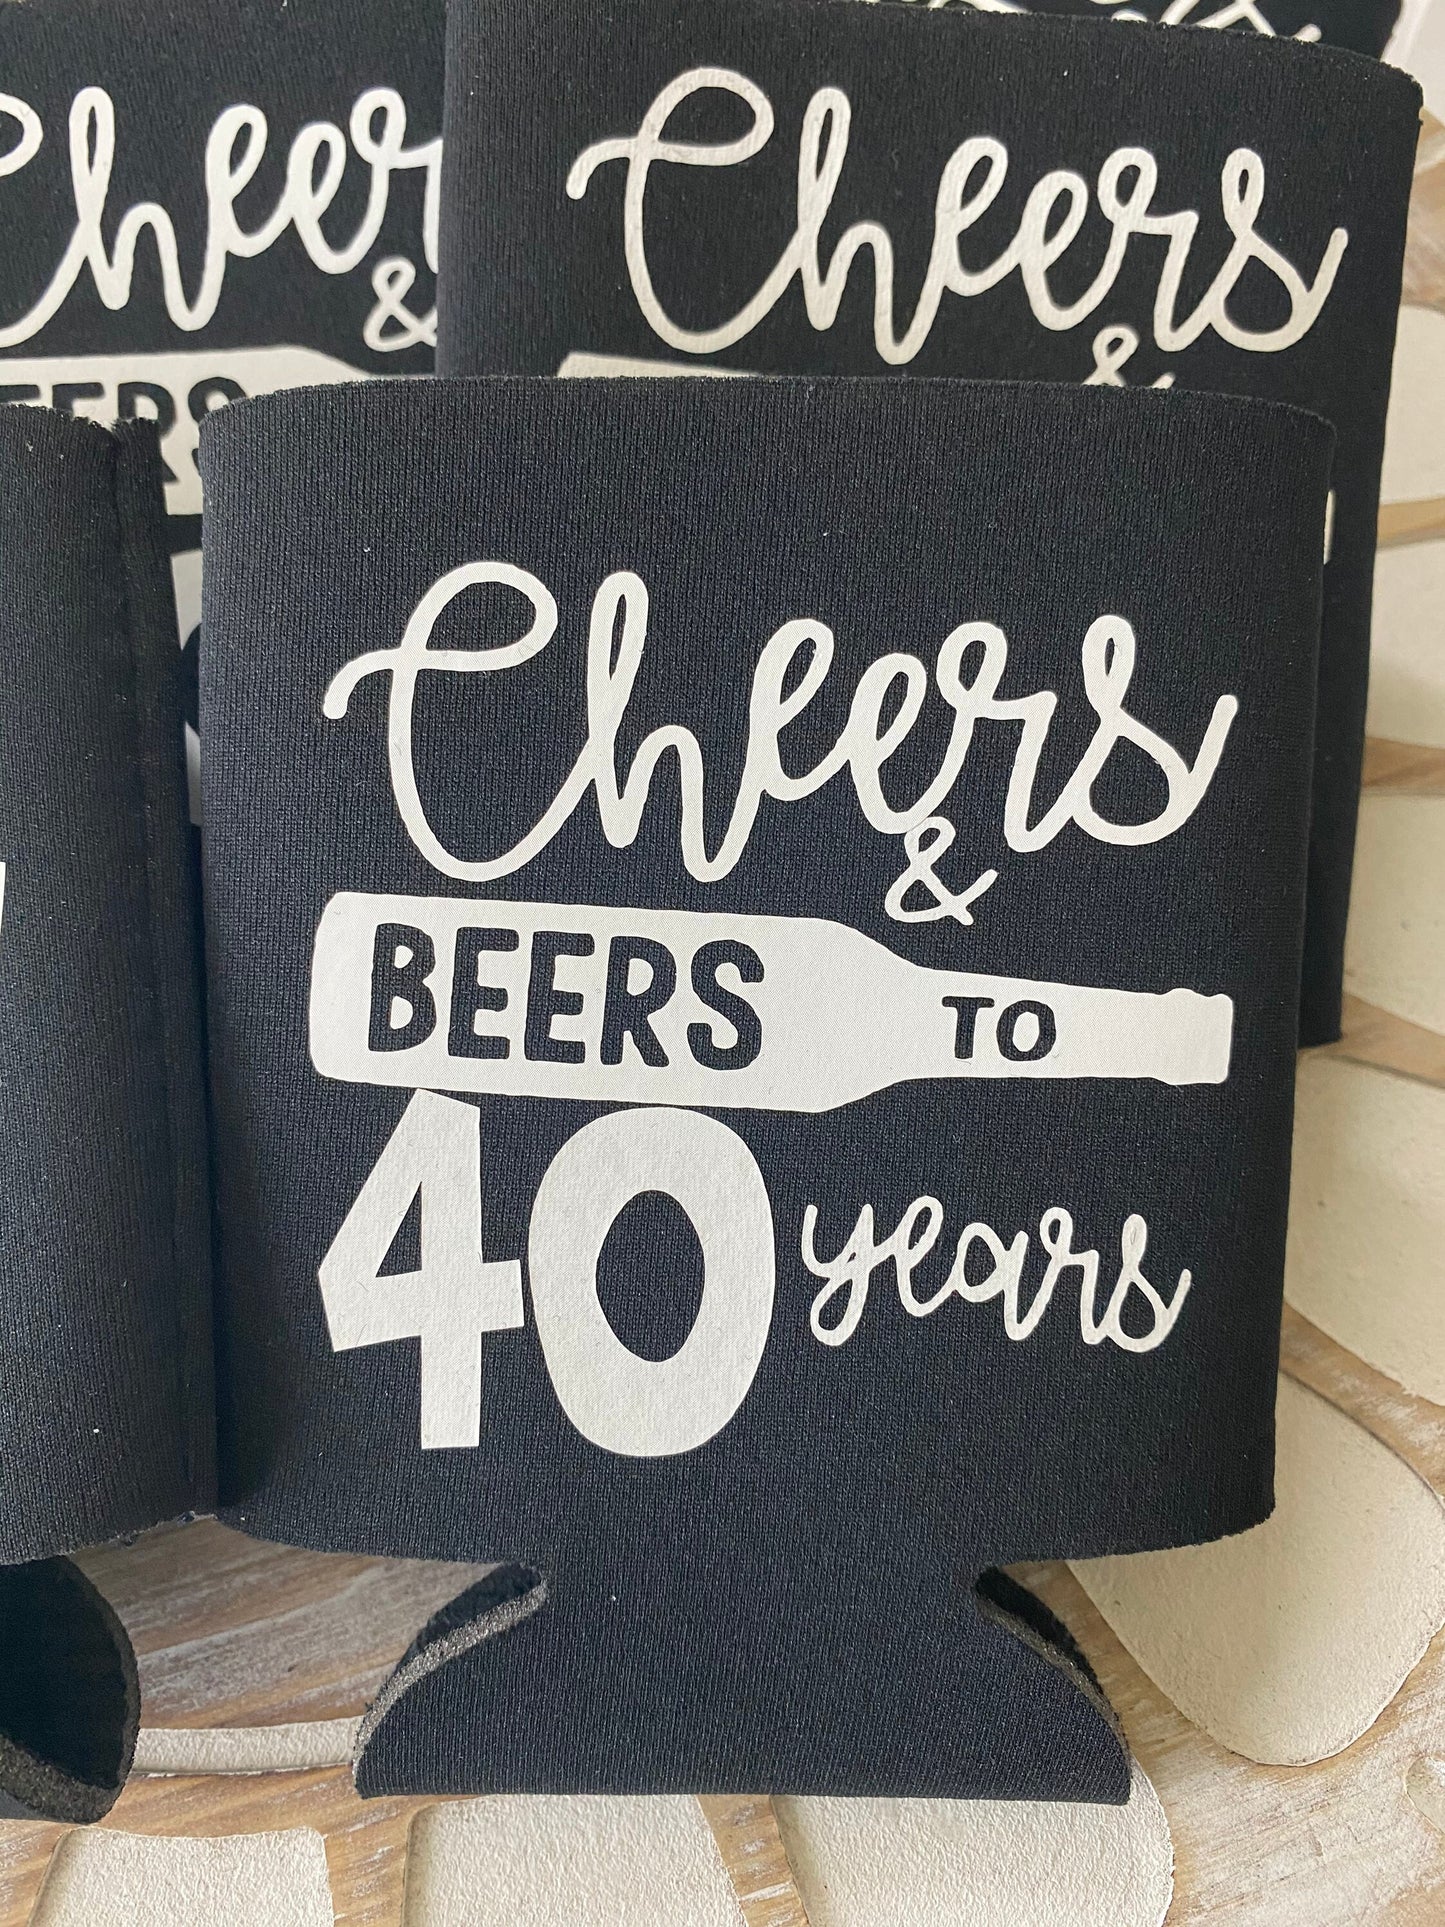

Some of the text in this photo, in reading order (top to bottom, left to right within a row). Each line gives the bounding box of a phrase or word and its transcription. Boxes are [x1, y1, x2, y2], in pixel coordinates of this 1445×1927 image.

[363, 257, 439, 352] &
[566, 67, 1348, 364] Cheers
[322, 560, 1238, 883] Cheers
[885, 816, 998, 925] &
[368, 922, 1057, 1071] BEERS TO
[318, 1088, 1192, 1459] 40 years
